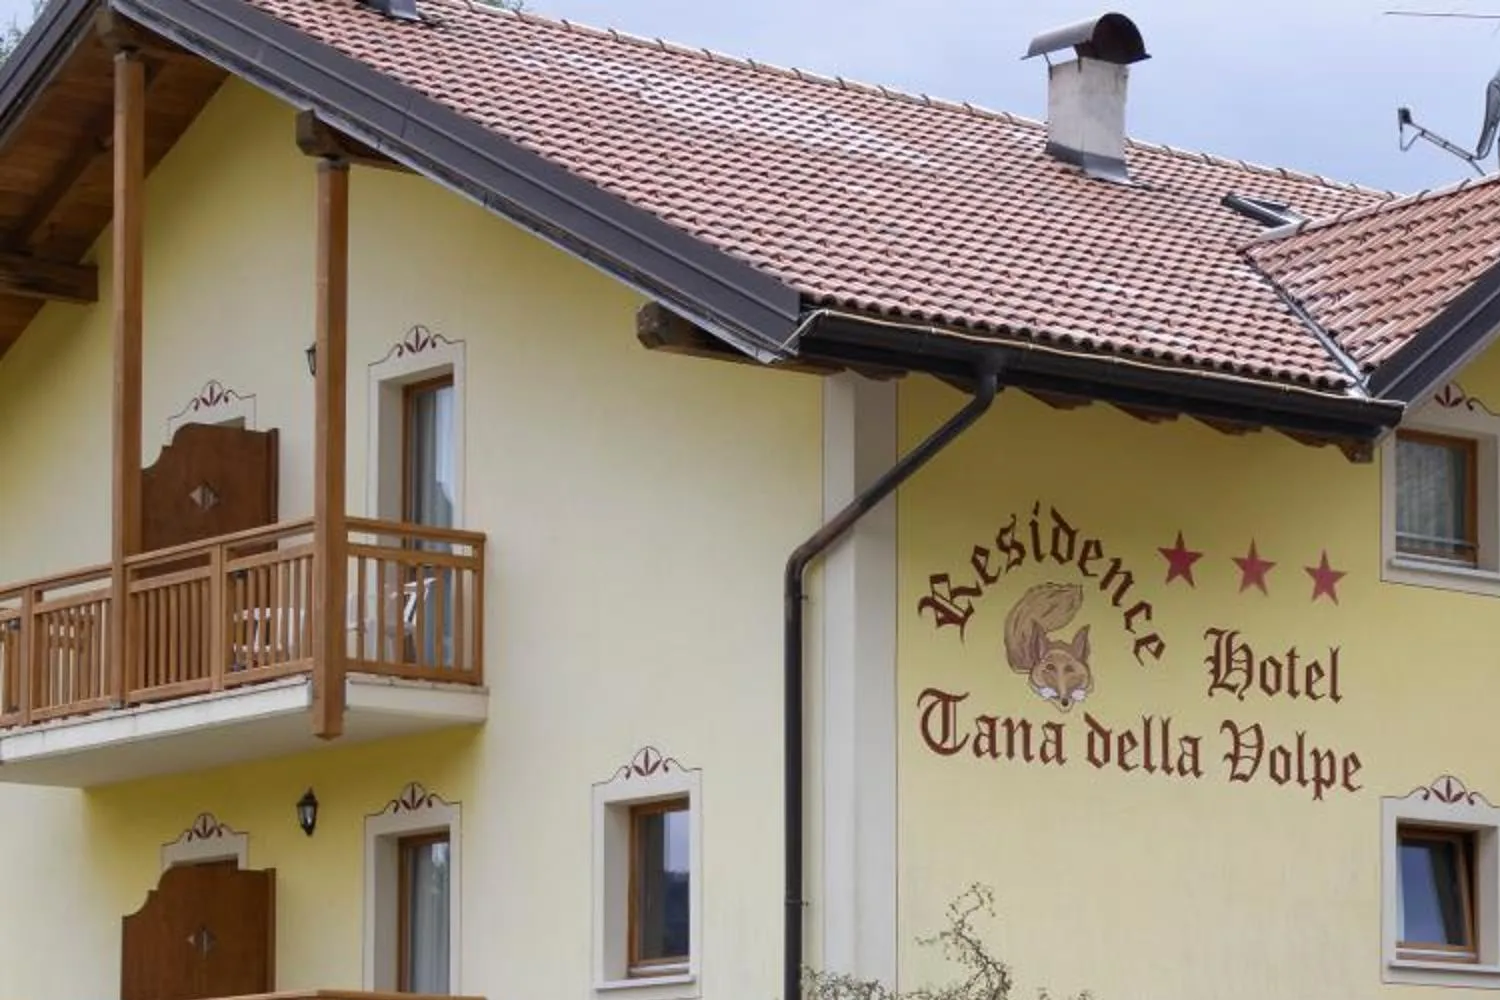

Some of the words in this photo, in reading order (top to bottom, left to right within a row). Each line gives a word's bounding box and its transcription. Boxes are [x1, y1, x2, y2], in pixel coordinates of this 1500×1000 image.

[918, 500, 1166, 667] Residence
[1203, 627, 1343, 704] Hotel
[917, 687, 1068, 766] Tana
[1083, 712, 1204, 779] della
[1220, 719, 1364, 801] Volpe
